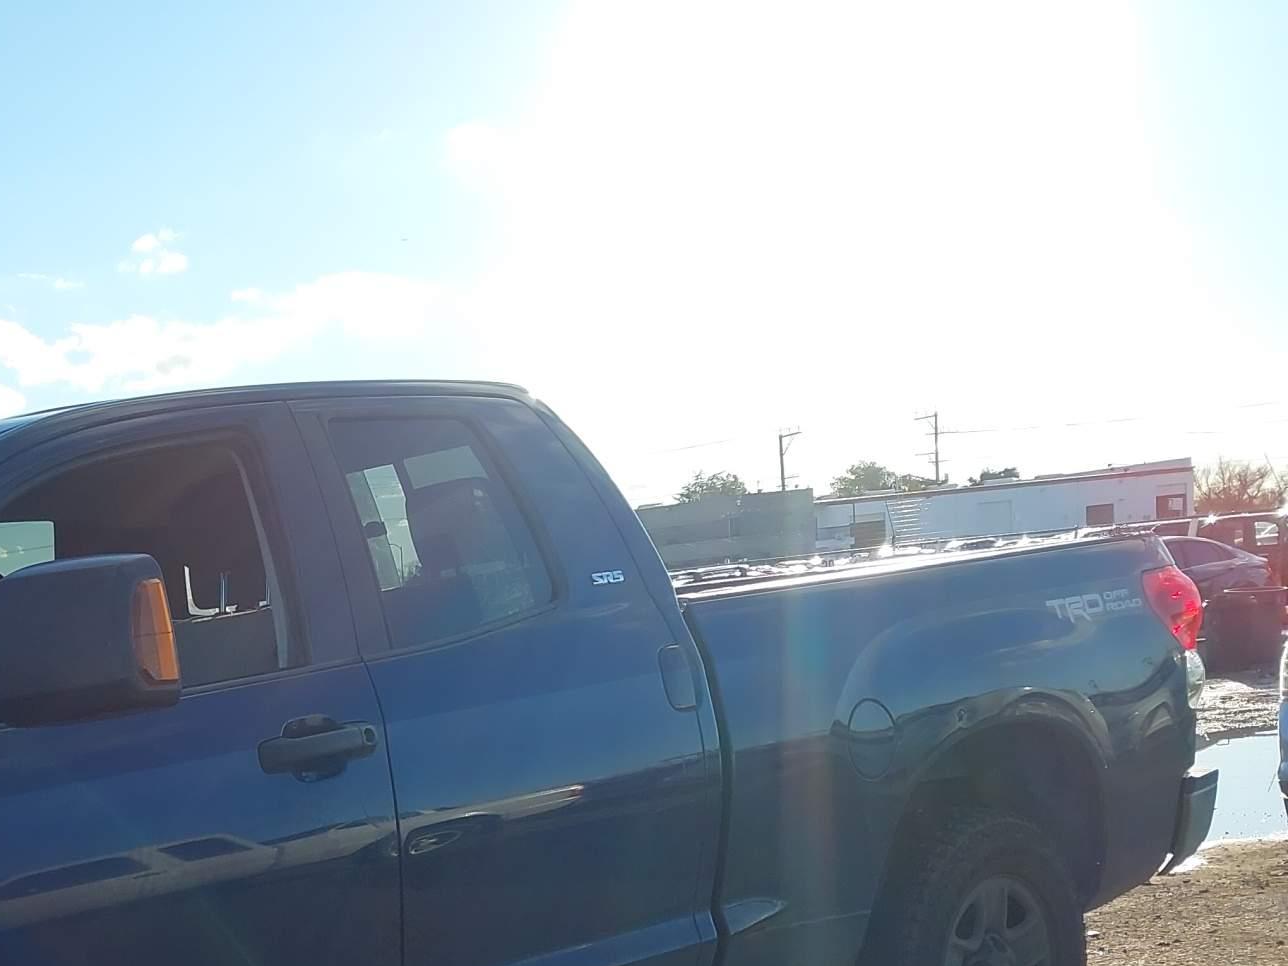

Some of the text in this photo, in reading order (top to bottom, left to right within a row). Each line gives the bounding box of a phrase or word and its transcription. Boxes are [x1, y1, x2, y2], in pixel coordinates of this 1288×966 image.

[1045, 588, 1129, 623] TRD OFF
[1105, 598, 1143, 611] ROAD
